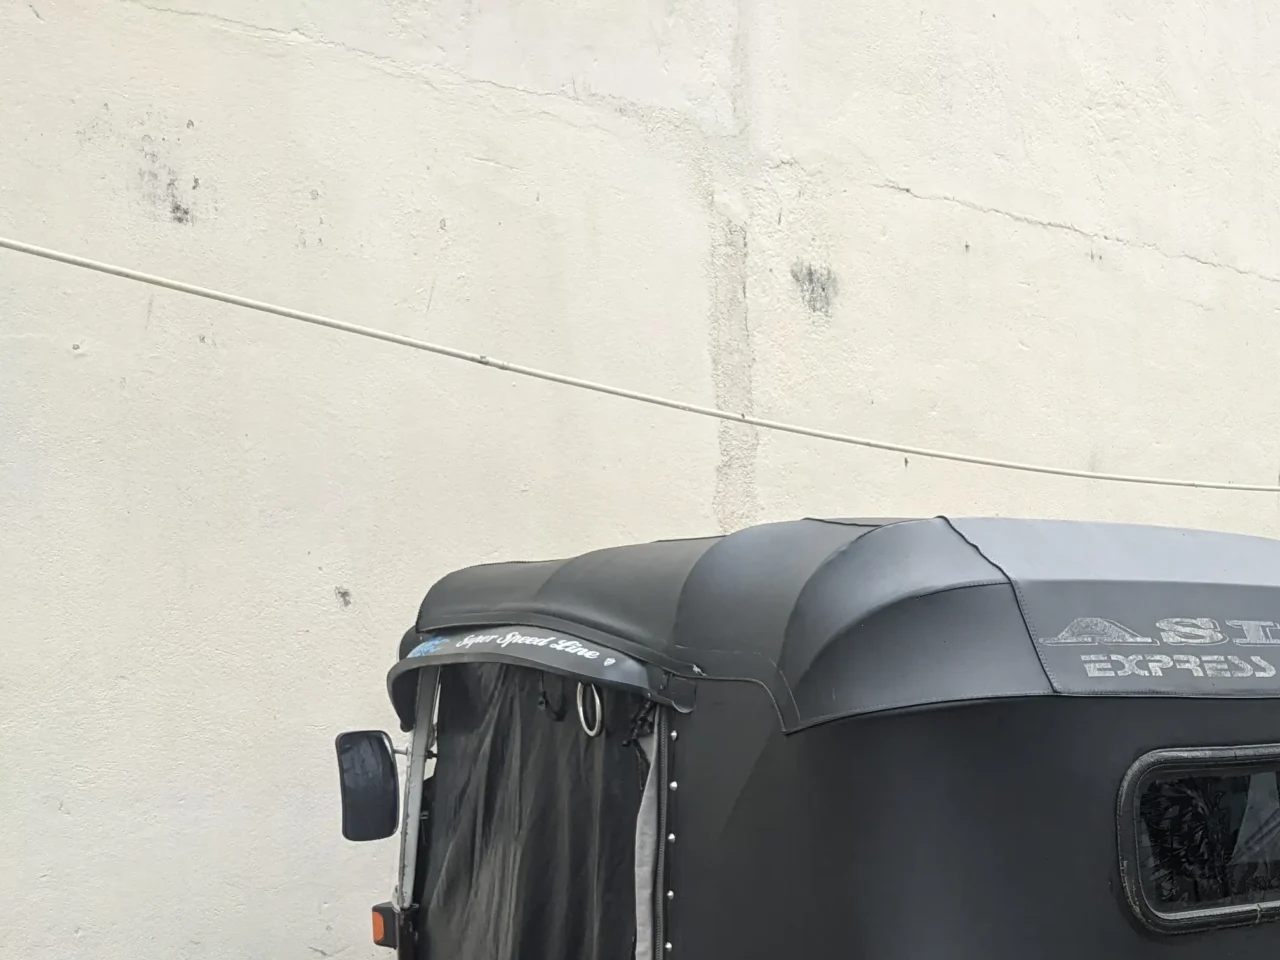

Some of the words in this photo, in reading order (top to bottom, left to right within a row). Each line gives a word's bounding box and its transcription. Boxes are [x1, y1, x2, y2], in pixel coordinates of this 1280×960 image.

[456, 634, 498, 649] Super
[496, 631, 557, 648] Speed
[549, 639, 600, 659] Line
[1080, 653, 1277, 679] EXPRESS
